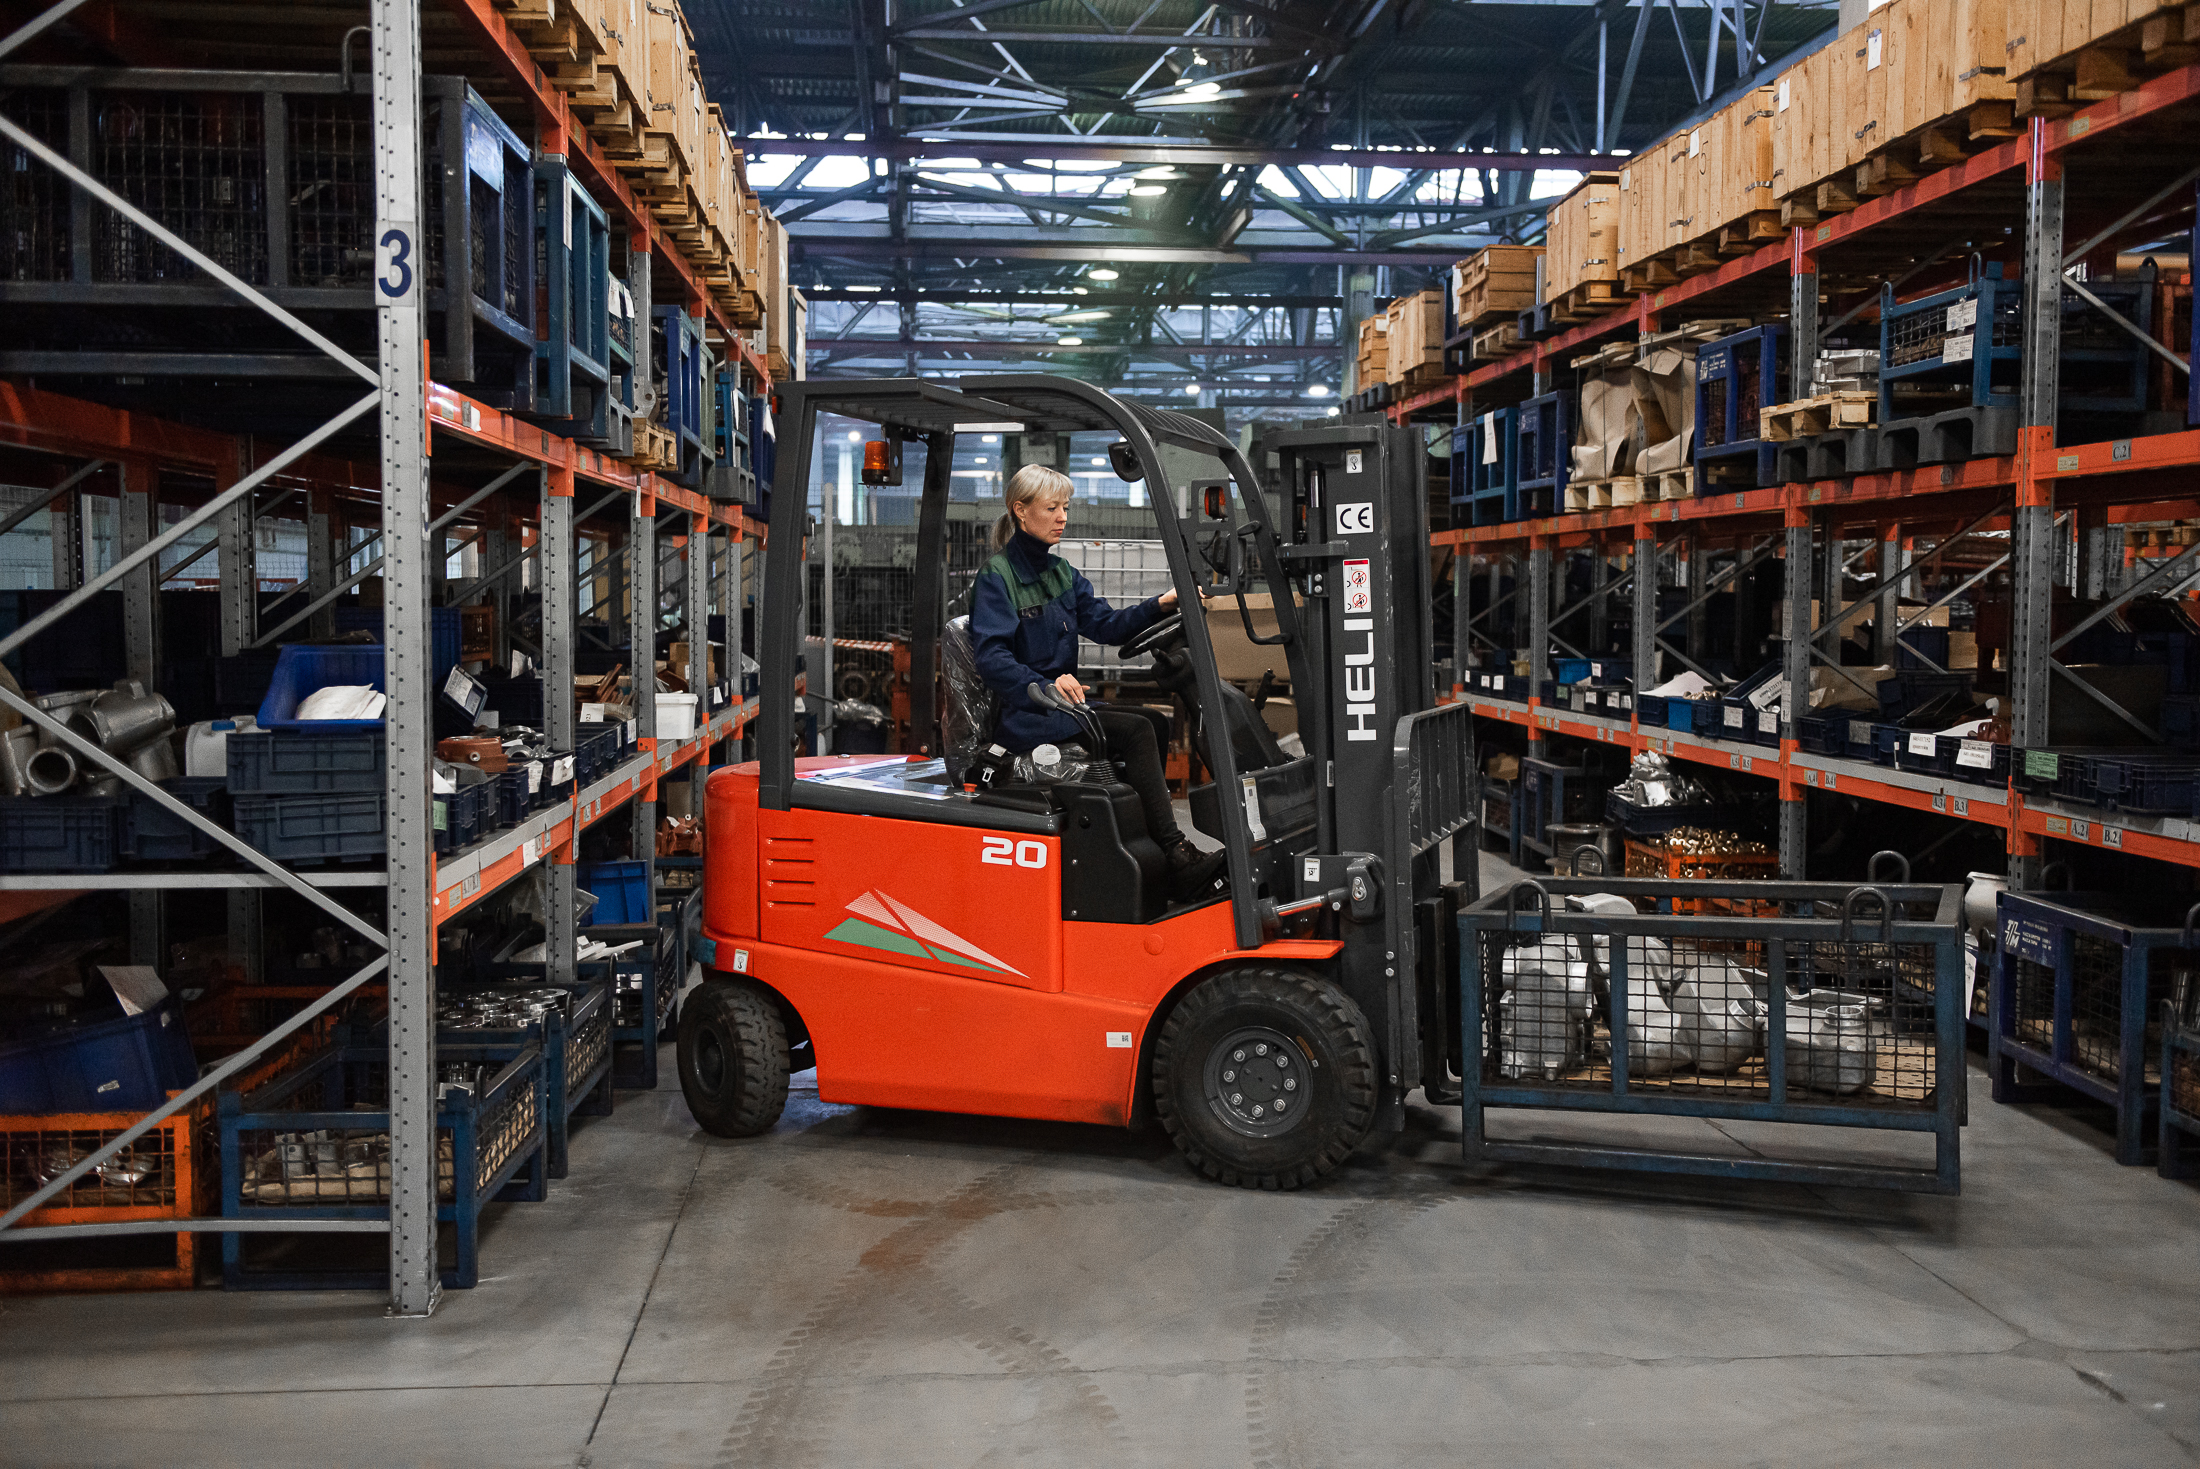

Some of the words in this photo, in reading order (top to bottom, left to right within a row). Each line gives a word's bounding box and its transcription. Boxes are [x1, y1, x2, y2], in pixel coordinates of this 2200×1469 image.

[379, 229, 412, 298] 3
[1340, 506, 1371, 530] CE
[1344, 617, 1377, 741] HELI
[981, 836, 1048, 869] 20
